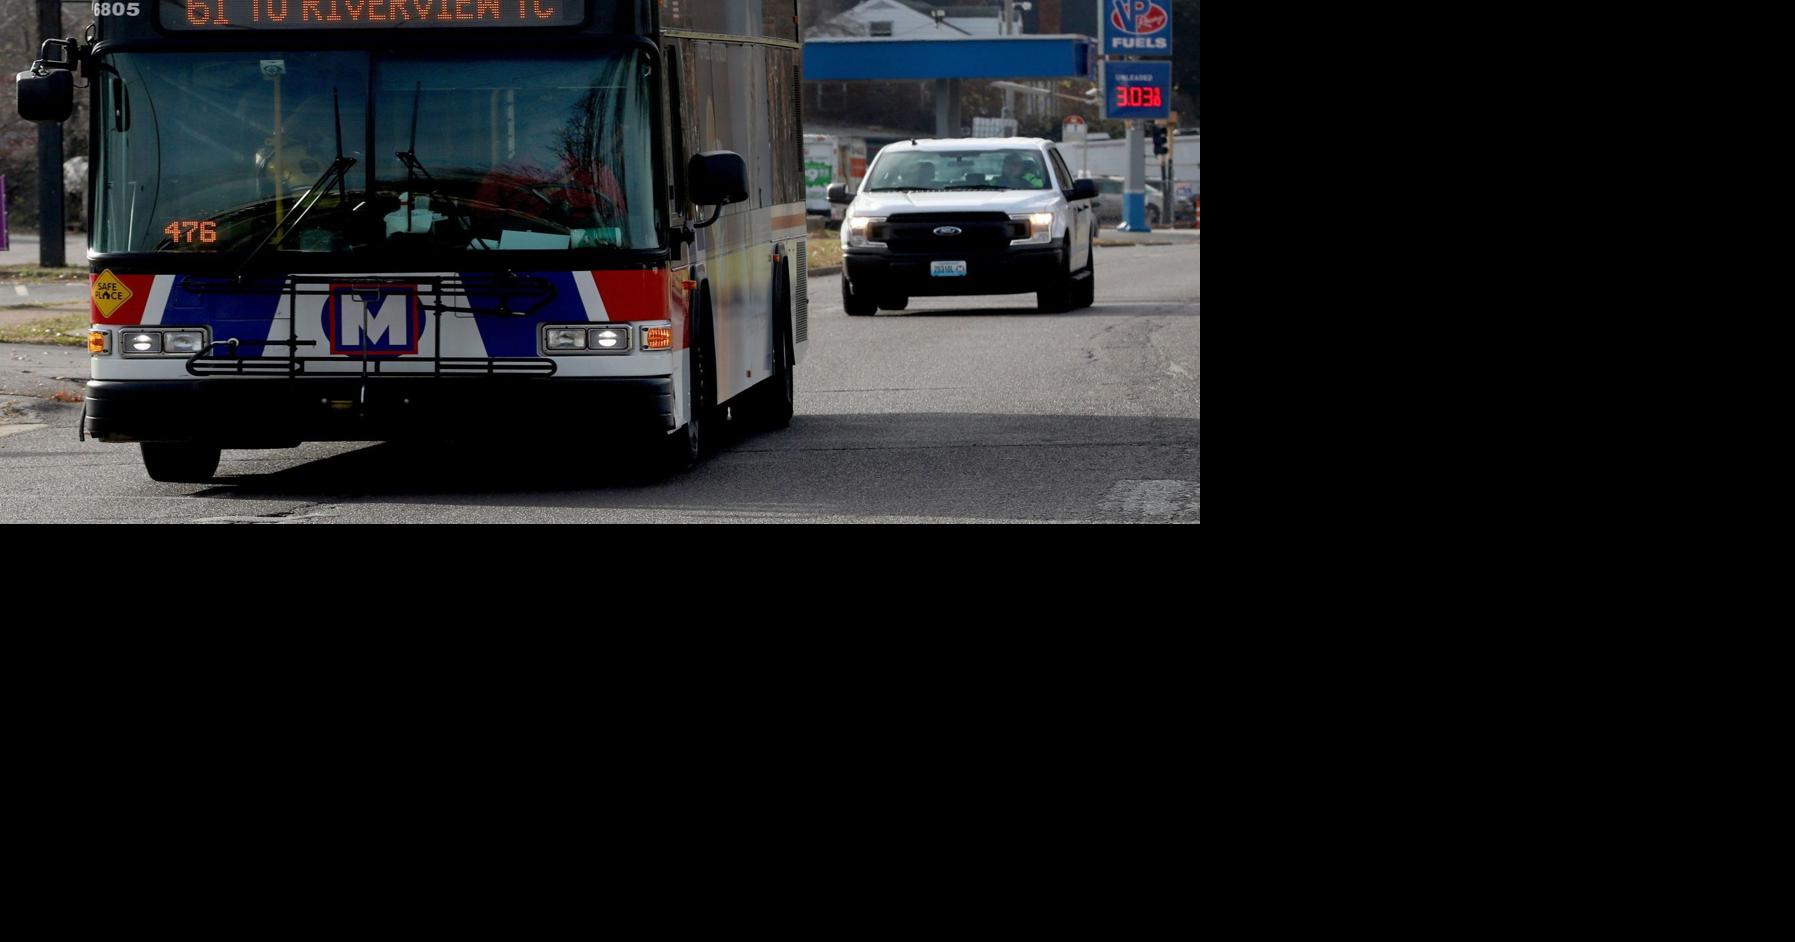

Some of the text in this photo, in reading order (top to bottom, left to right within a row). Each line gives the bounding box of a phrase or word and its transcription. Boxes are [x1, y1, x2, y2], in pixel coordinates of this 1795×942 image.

[94, 2, 141, 17] 6805
[1112, 37, 1167, 48] FUELS
[1115, 74, 1153, 82] UNLEADED
[164, 221, 217, 243] 476
[97, 282, 117, 291] SAFE
[341, 293, 407, 346] M
